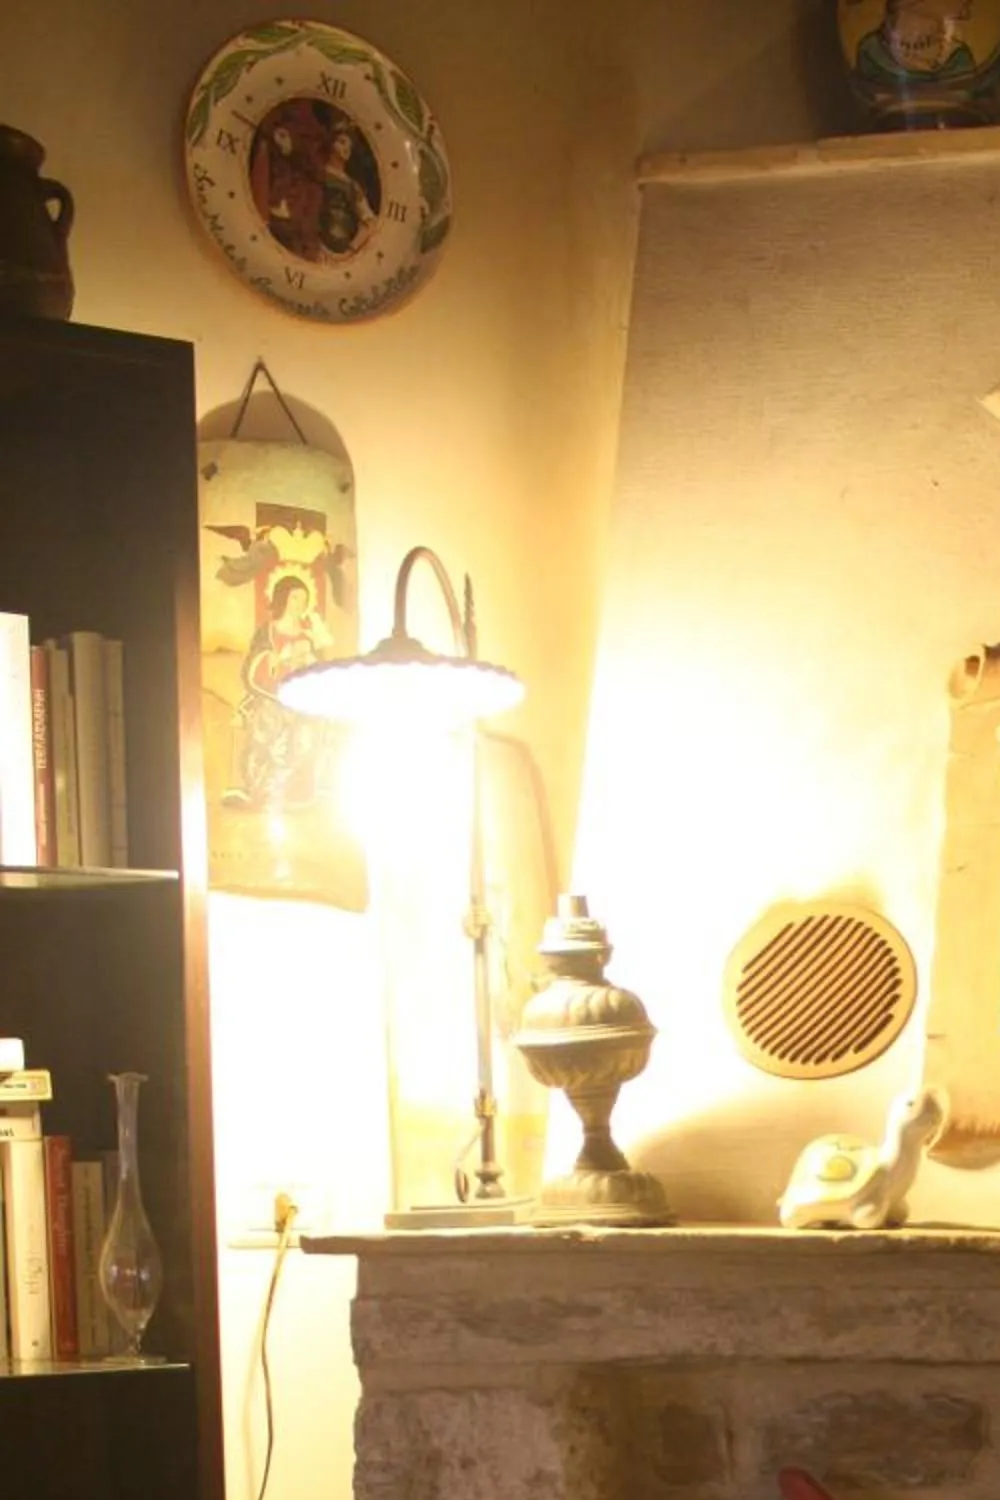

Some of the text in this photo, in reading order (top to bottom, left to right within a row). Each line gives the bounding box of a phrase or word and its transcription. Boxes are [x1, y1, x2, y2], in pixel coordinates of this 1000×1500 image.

[316, 71, 347, 99] XII
[216, 128, 239, 155] IX
[386, 201, 408, 223] III
[284, 266, 306, 289] VI
